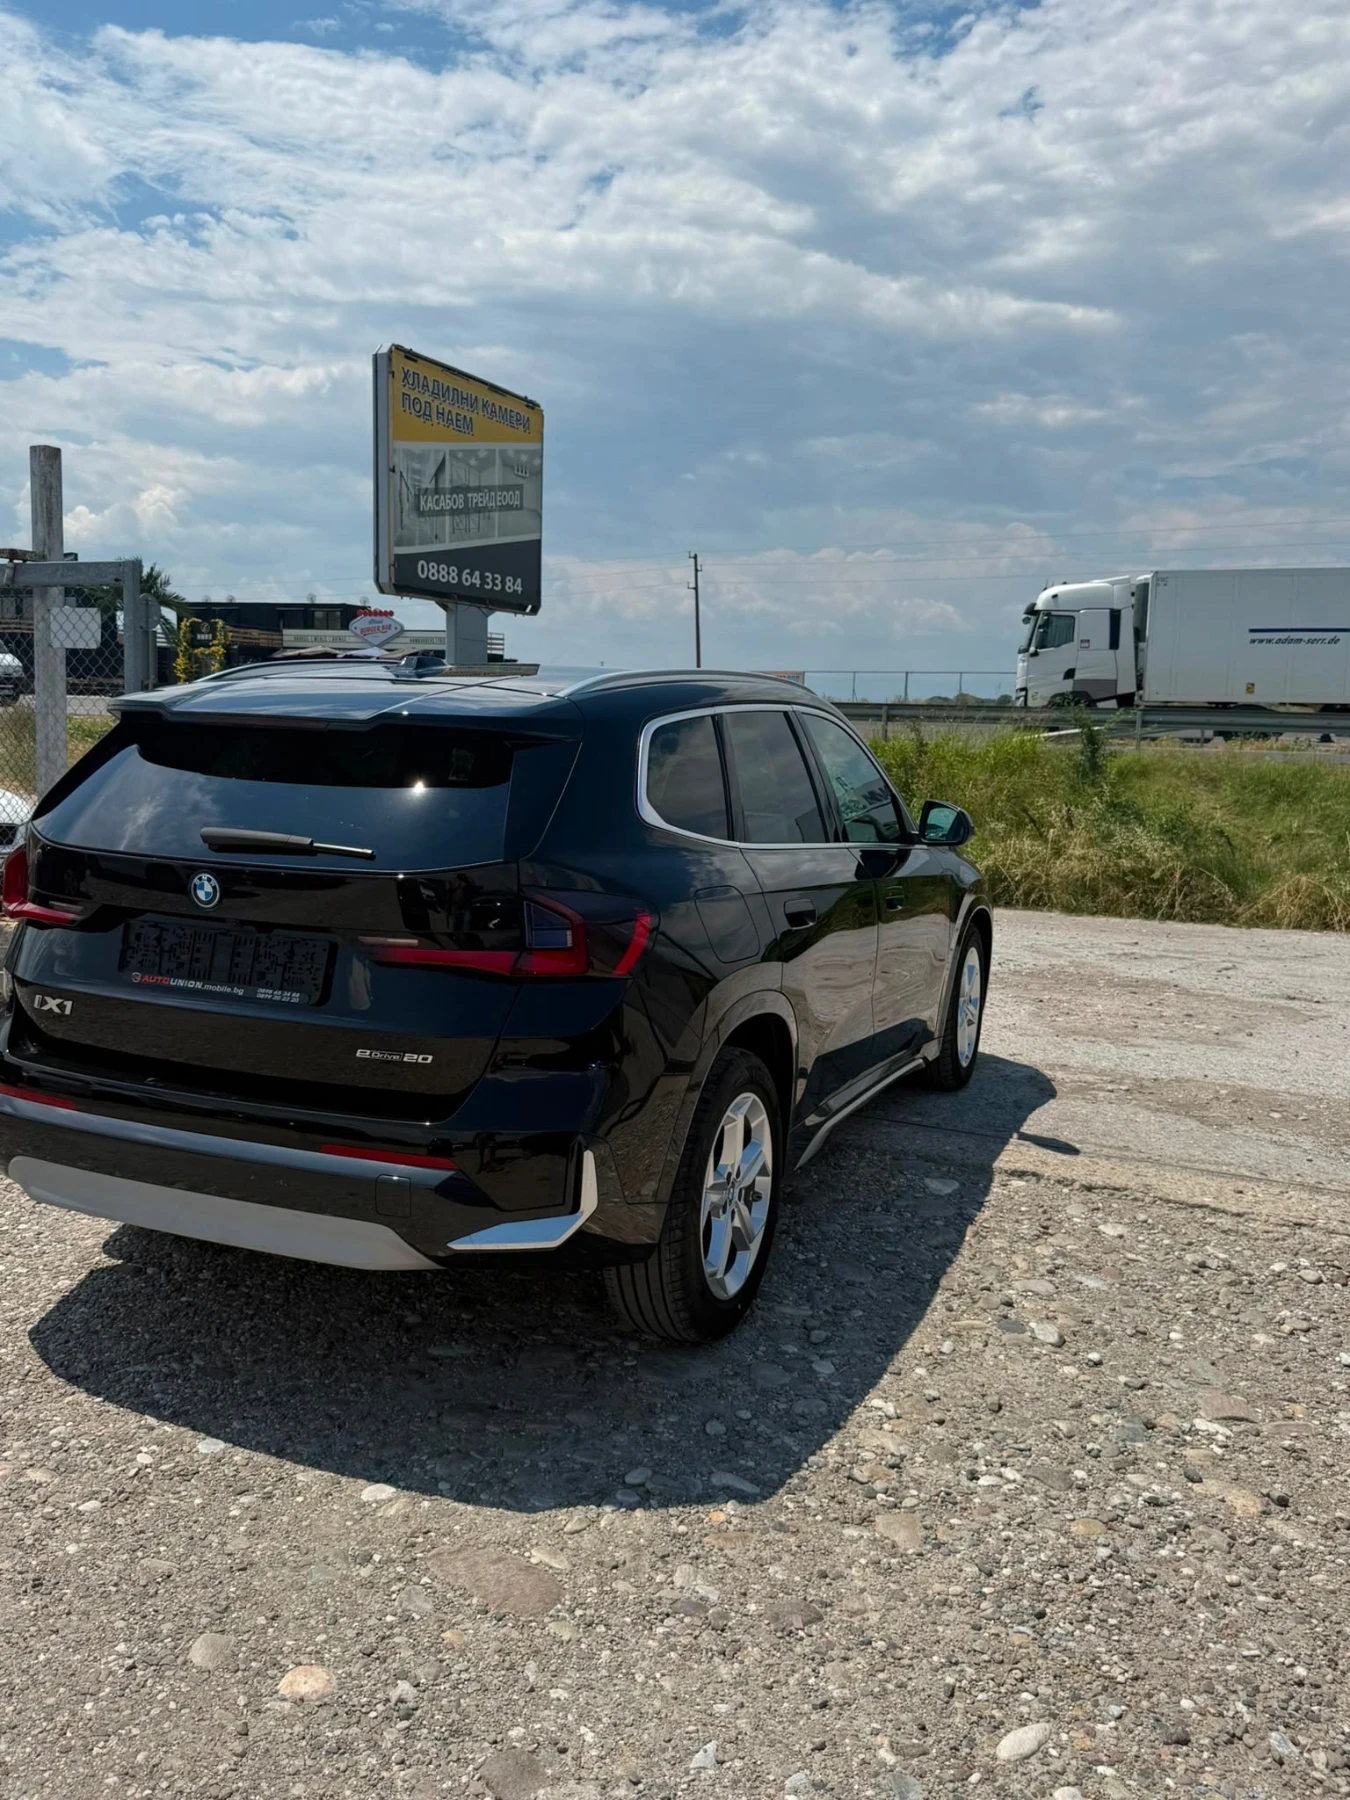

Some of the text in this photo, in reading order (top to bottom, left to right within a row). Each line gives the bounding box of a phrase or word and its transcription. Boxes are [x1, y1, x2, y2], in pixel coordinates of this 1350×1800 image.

[401, 366, 531, 433] ХЛАДИЛНИ КАМЕРИ
[401, 391, 474, 435] ПОД НАЕМ
[420, 489, 521, 511] КАСАБОВ ТРЕЙД ЕООД
[417, 560, 523, 595] 0888 64 33 84
